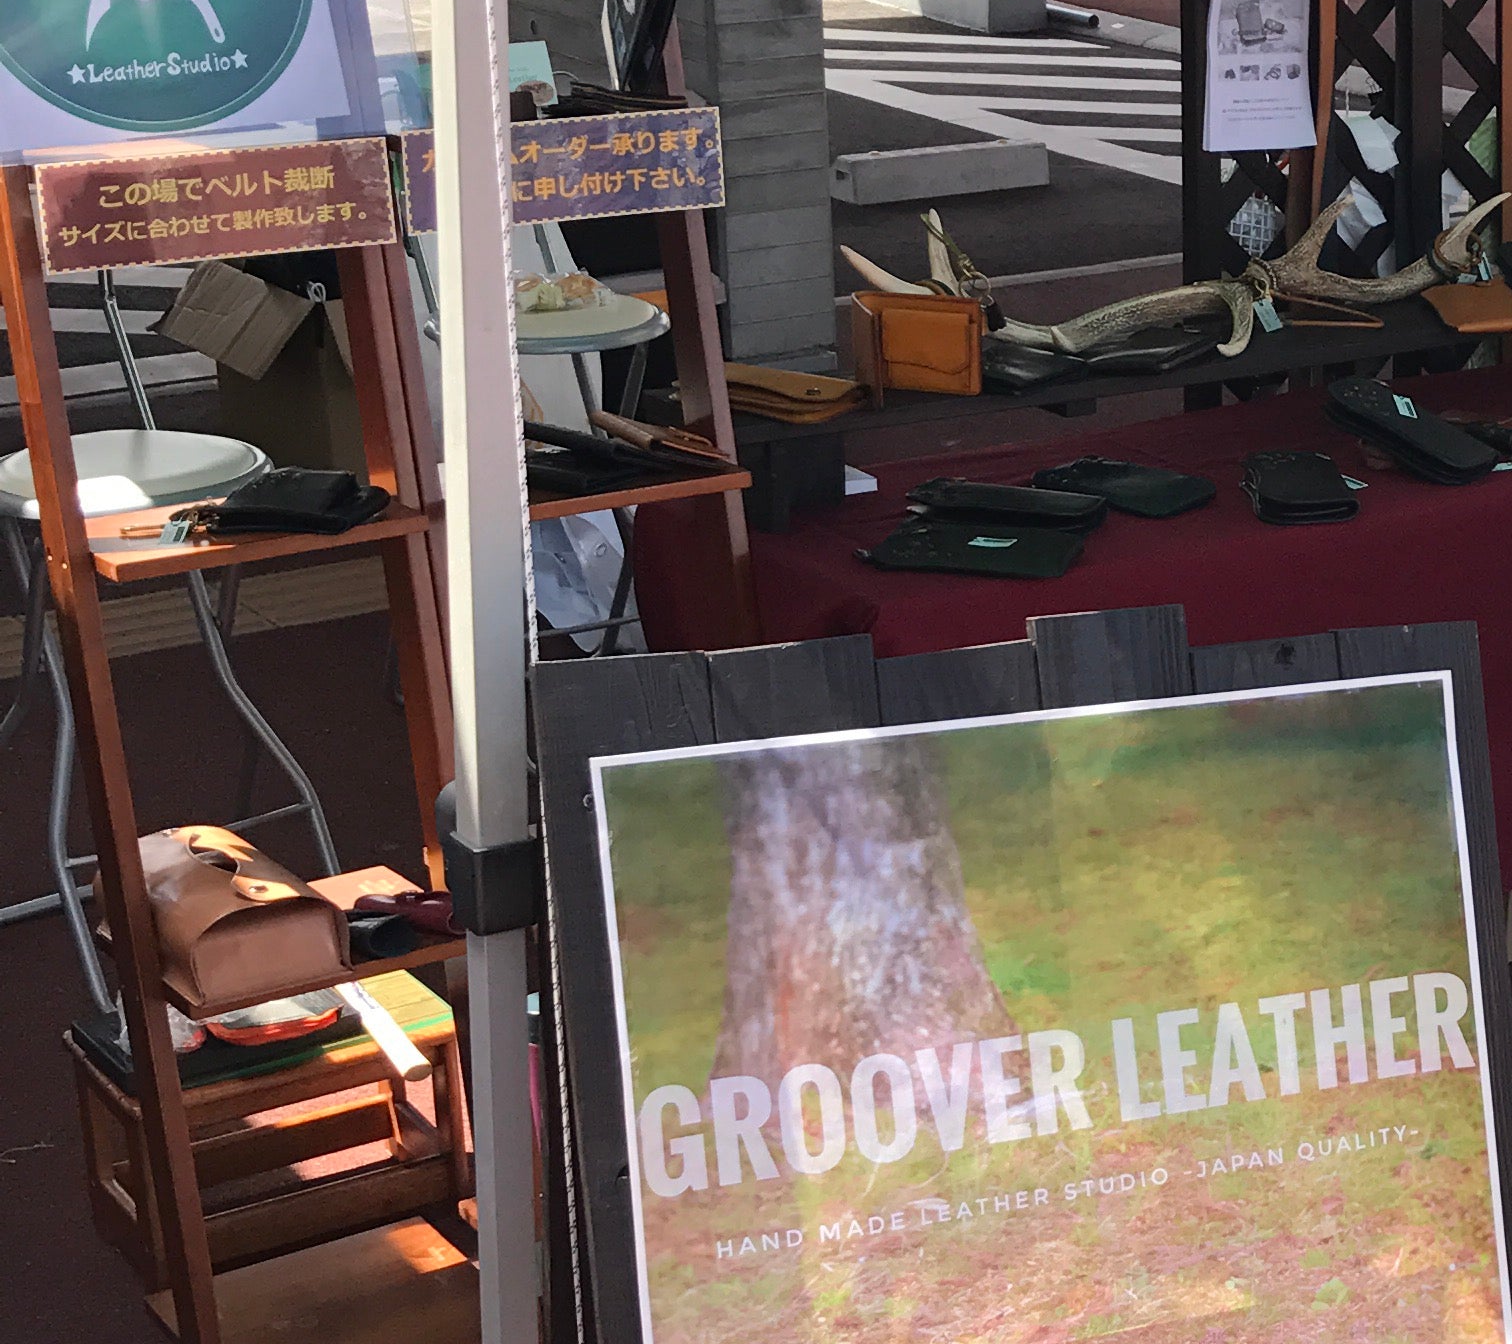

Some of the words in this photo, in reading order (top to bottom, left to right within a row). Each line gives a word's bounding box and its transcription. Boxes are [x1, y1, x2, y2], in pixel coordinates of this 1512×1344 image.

[98, 164, 336, 208] この場でベルト裁断
[58, 200, 368, 248] サイズに合わせて製作致します。
[638, 1028, 1092, 1198] GROOVER
[1110, 971, 1477, 1123] LEATHER
[715, 1226, 805, 1260] HAND
[818, 1212, 908, 1241] MADE
[919, 1187, 1049, 1227] LEATHER
[1063, 1166, 1170, 1203] STUDIO
